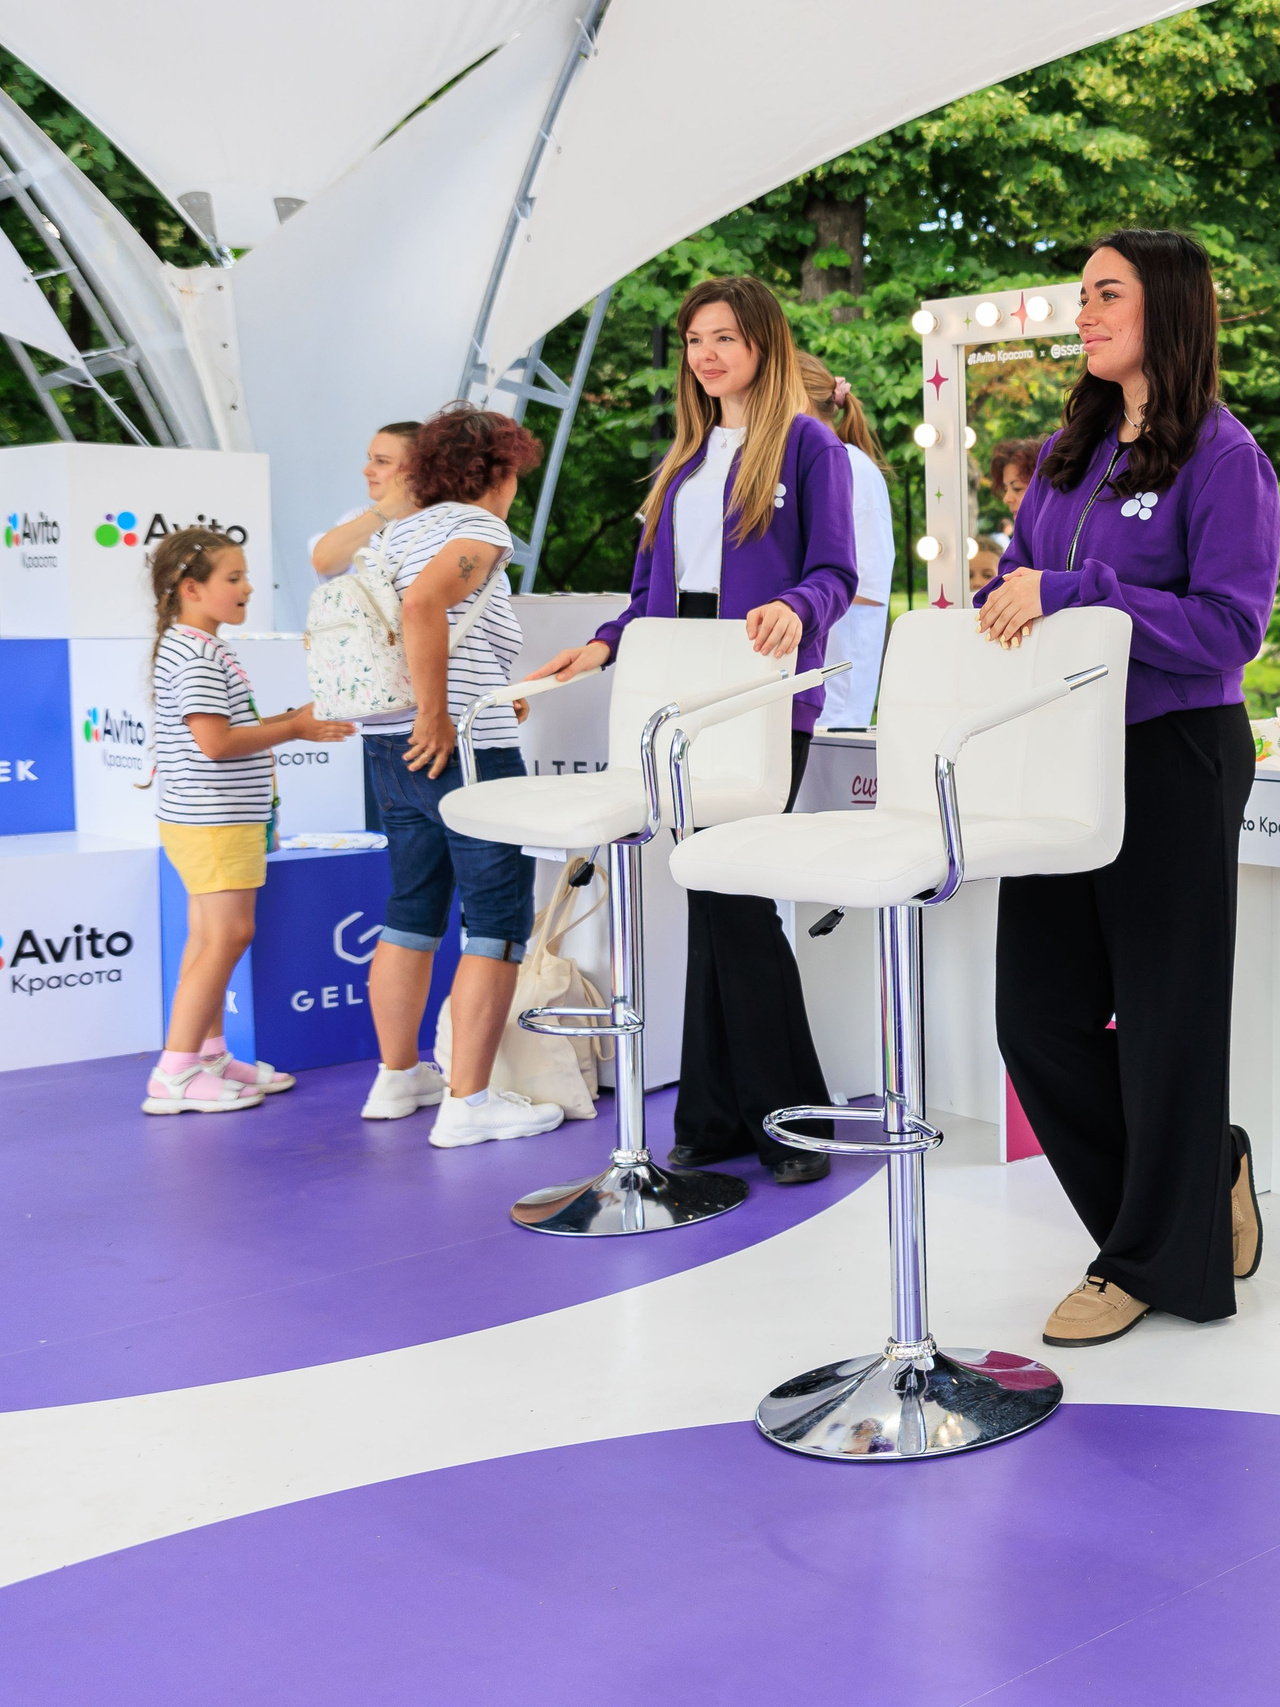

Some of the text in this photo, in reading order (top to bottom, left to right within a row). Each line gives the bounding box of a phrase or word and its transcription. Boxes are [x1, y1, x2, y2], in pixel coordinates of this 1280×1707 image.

[976, 351, 996, 363] Avito
[997, 349, 1034, 363] Красота
[1051, 343, 1085, 359] essen
[22, 511, 60, 545] Avito
[144, 513, 248, 545] Ato
[102, 709, 145, 746] Avito
[274, 752, 329, 766] сота
[10, 924, 134, 967] Avito
[11, 968, 122, 996] Красота
[291, 982, 370, 1012] GEL
